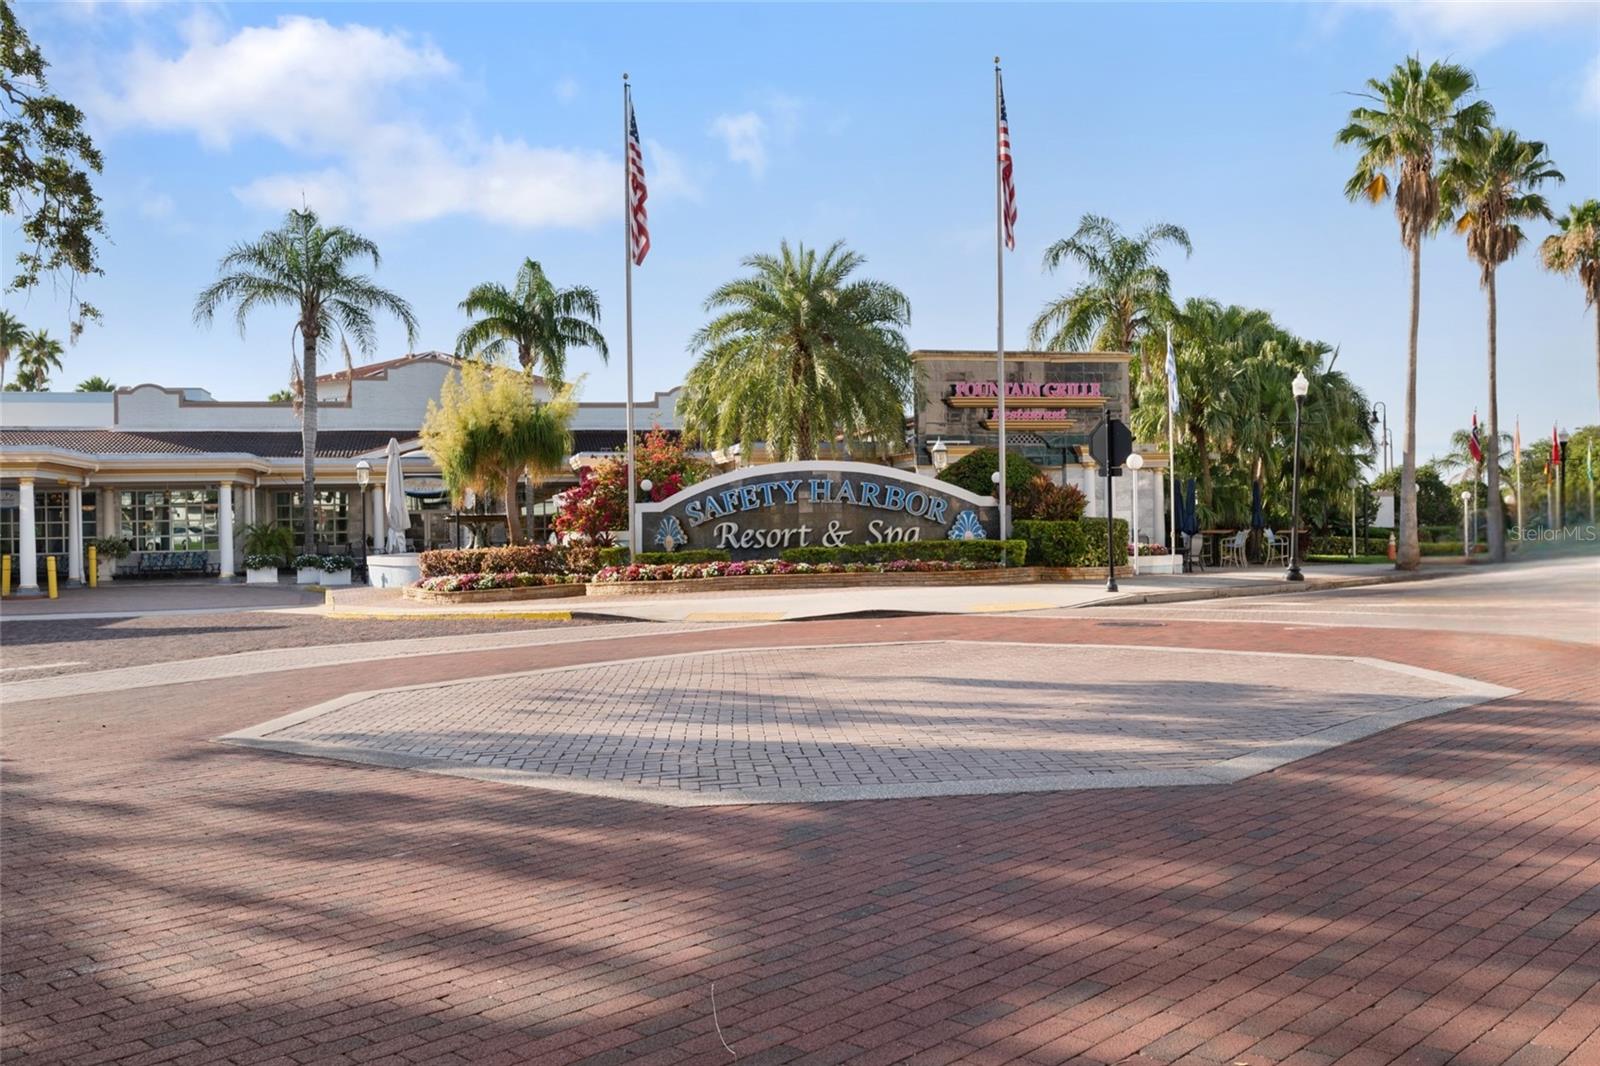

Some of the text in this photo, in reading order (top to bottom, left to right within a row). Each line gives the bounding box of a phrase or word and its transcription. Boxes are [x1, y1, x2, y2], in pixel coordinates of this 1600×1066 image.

[955, 381, 1102, 397] FOUNTAIN GRILLE
[685, 479, 948, 527] SAFETY HARBOR
[713, 520, 922, 549] Resort & Spa
